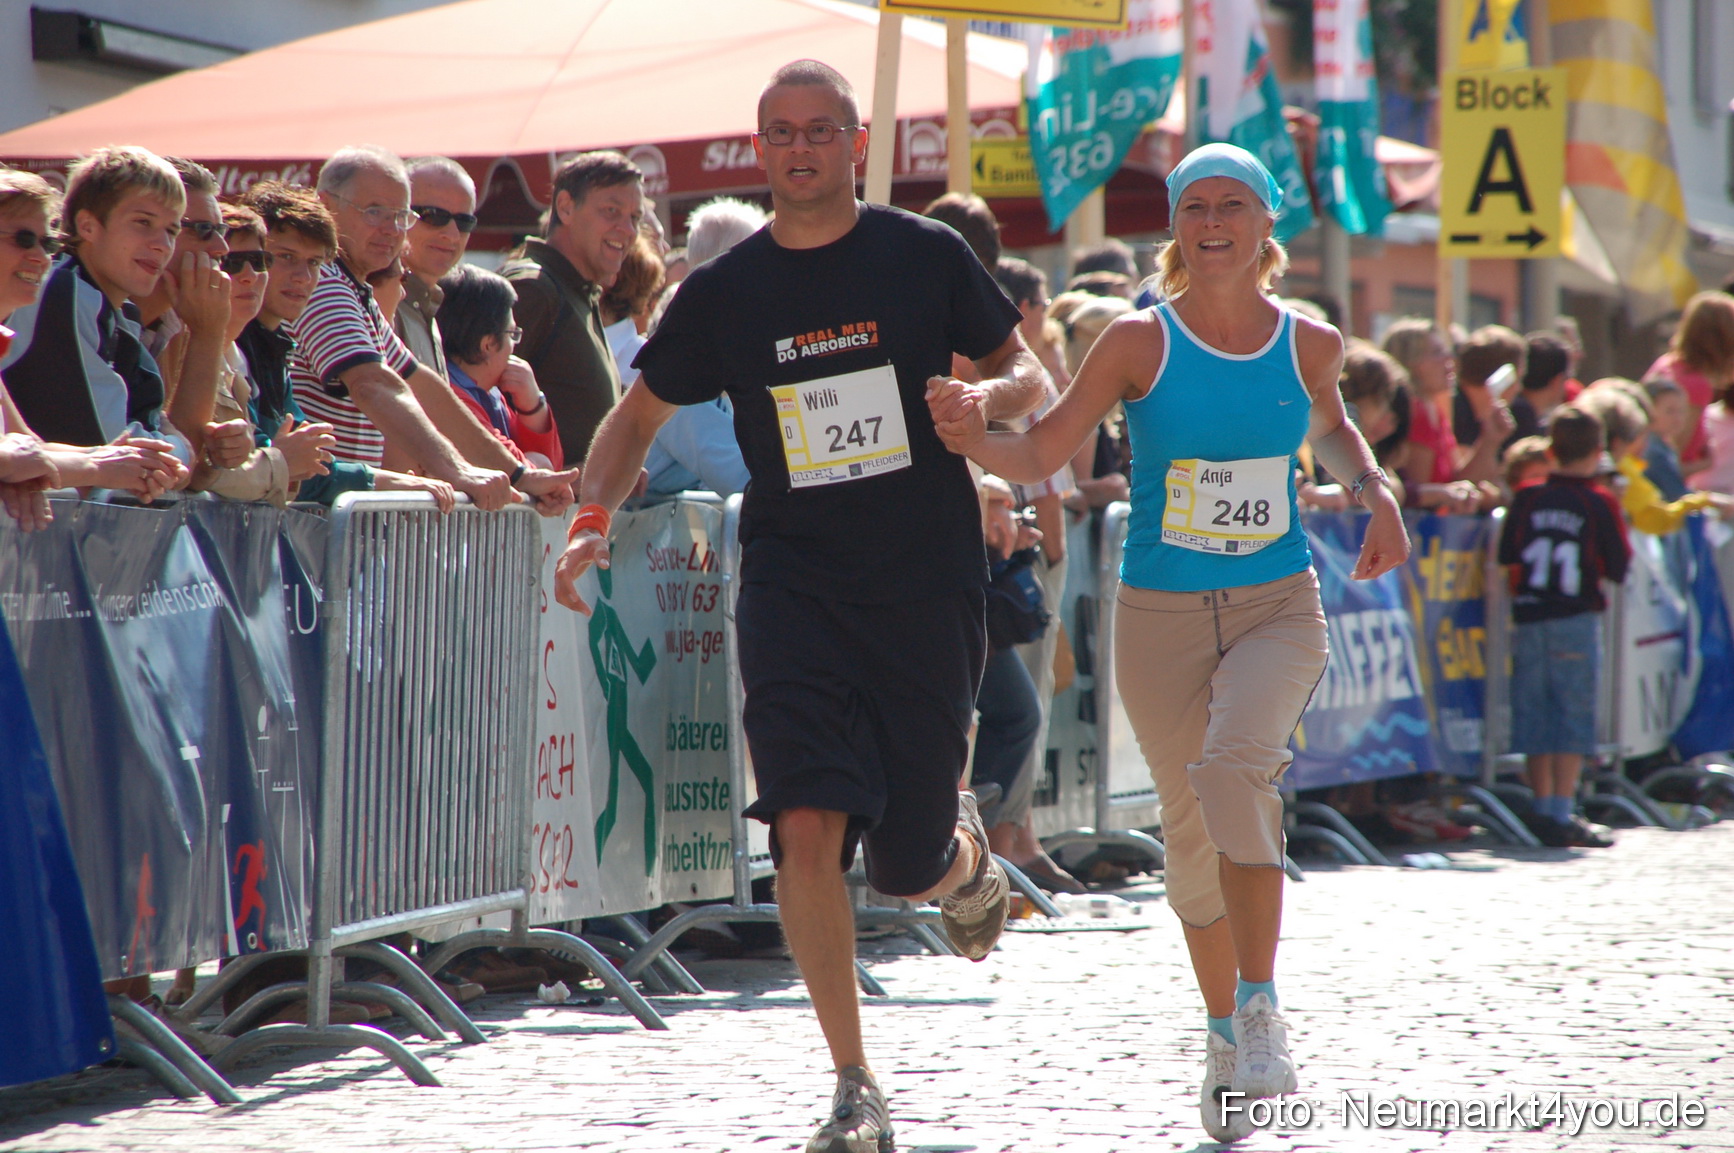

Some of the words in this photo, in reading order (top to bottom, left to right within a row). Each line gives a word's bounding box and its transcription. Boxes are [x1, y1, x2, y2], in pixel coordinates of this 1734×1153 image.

[1455, 75, 1554, 111] Block
[1466, 123, 1536, 216] A
[795, 328, 836, 347] REAL
[841, 321, 878, 336] MEN
[777, 348, 797, 364] DO
[801, 333, 869, 357] AEROBICS
[803, 388, 838, 411] Willi
[825, 415, 883, 453] 247
[862, 451, 909, 469] PFLEIDERER
[1200, 468, 1232, 488] Anja
[1211, 499, 1270, 527] 248
[1164, 530, 1210, 547] BOCK
[1521, 536, 1582, 598] 11
